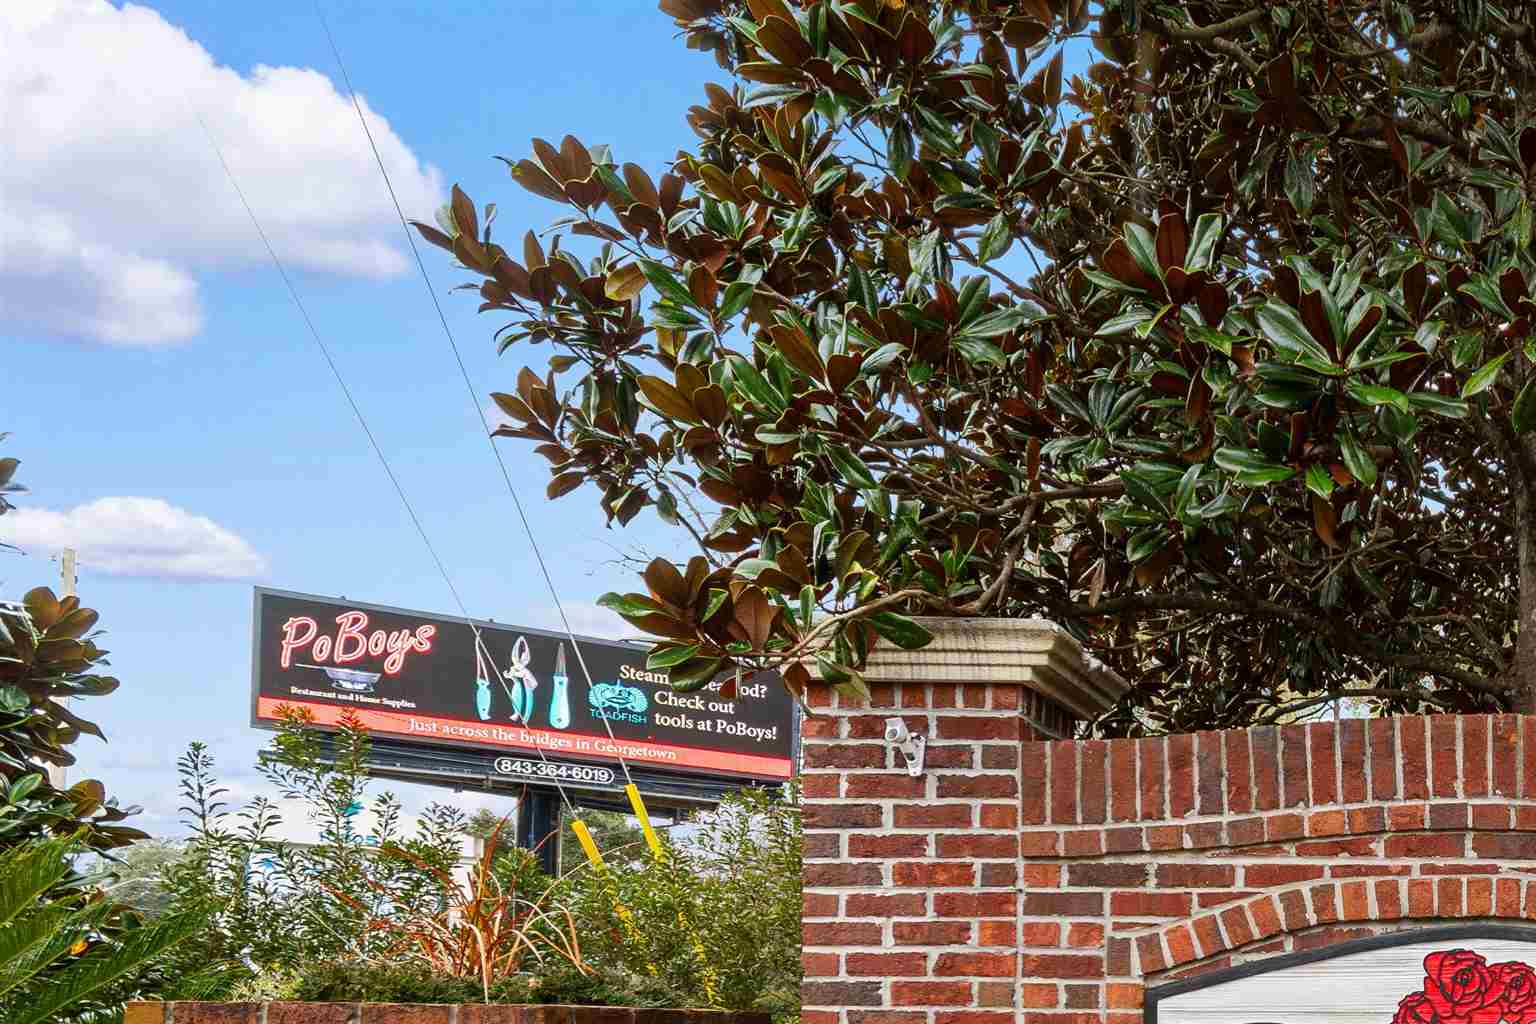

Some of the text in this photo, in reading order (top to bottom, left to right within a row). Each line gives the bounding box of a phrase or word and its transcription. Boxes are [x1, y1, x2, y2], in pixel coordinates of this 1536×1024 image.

[280, 611, 435, 674] PoBoys
[619, 664, 672, 686] Steam
[289, 686, 417, 709] Restaurant and Home Supplies
[653, 690, 736, 715] Check out
[589, 708, 648, 724] TOADFISH
[655, 712, 777, 741] tools at PoBoys!
[408, 718, 676, 760] Just across the Bridges in Georgetown
